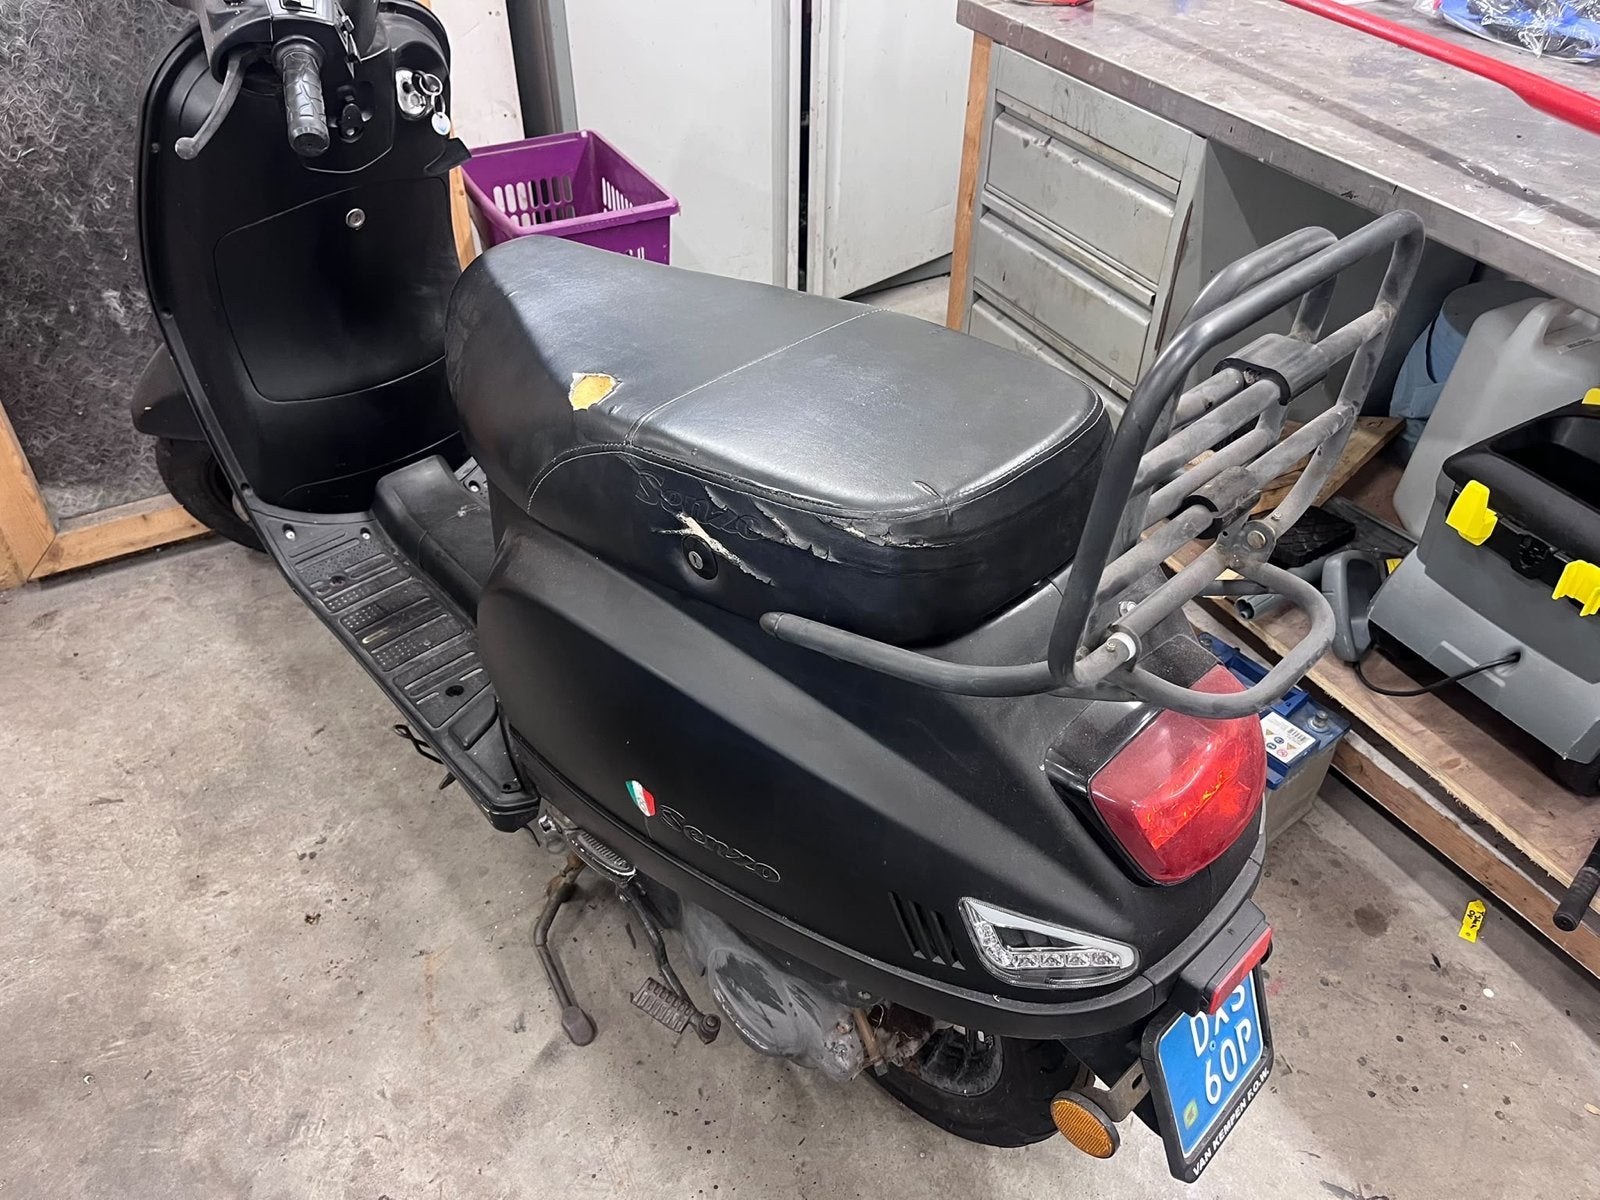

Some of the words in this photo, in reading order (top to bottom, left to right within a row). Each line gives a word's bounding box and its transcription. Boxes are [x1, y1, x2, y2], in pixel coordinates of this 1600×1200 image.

[635, 470, 763, 541] Senzo
[660, 804, 781, 883] Senzo
[1205, 1018, 1252, 1105] 60P
[1193, 1148, 1212, 1176] VAN
[1212, 1098, 1247, 1151] KEMPEN
